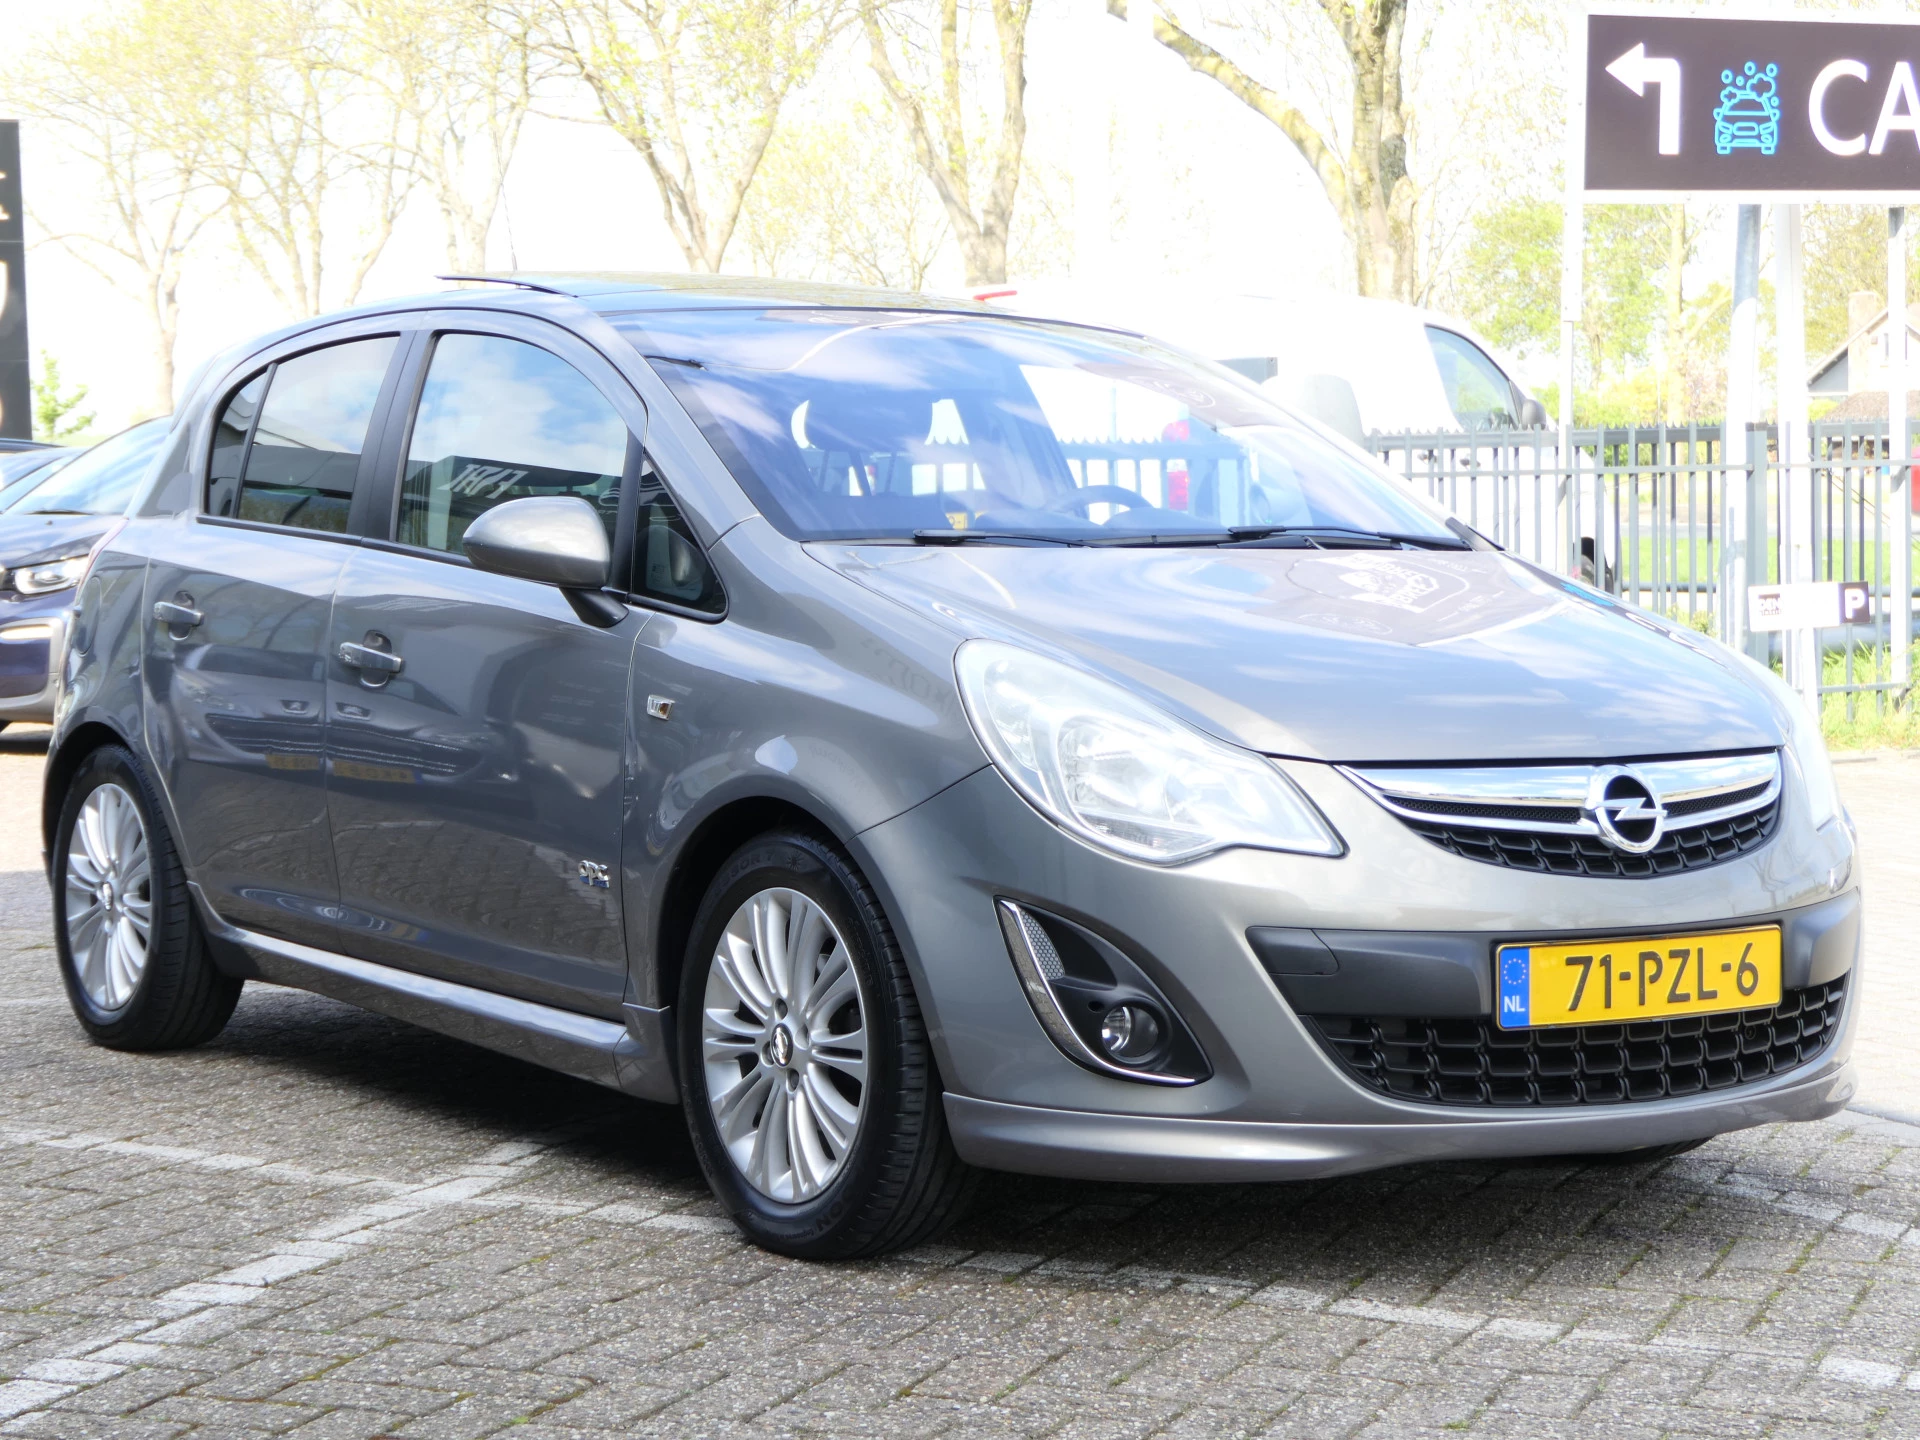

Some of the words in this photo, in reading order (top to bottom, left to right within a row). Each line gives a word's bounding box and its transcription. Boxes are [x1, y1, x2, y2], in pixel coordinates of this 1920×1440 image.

[1809, 59, 1920, 156] CA
[1844, 588, 1866, 619] P
[1565, 942, 1759, 1011] 71-PZL-6
[1503, 996, 1526, 1013] NL
